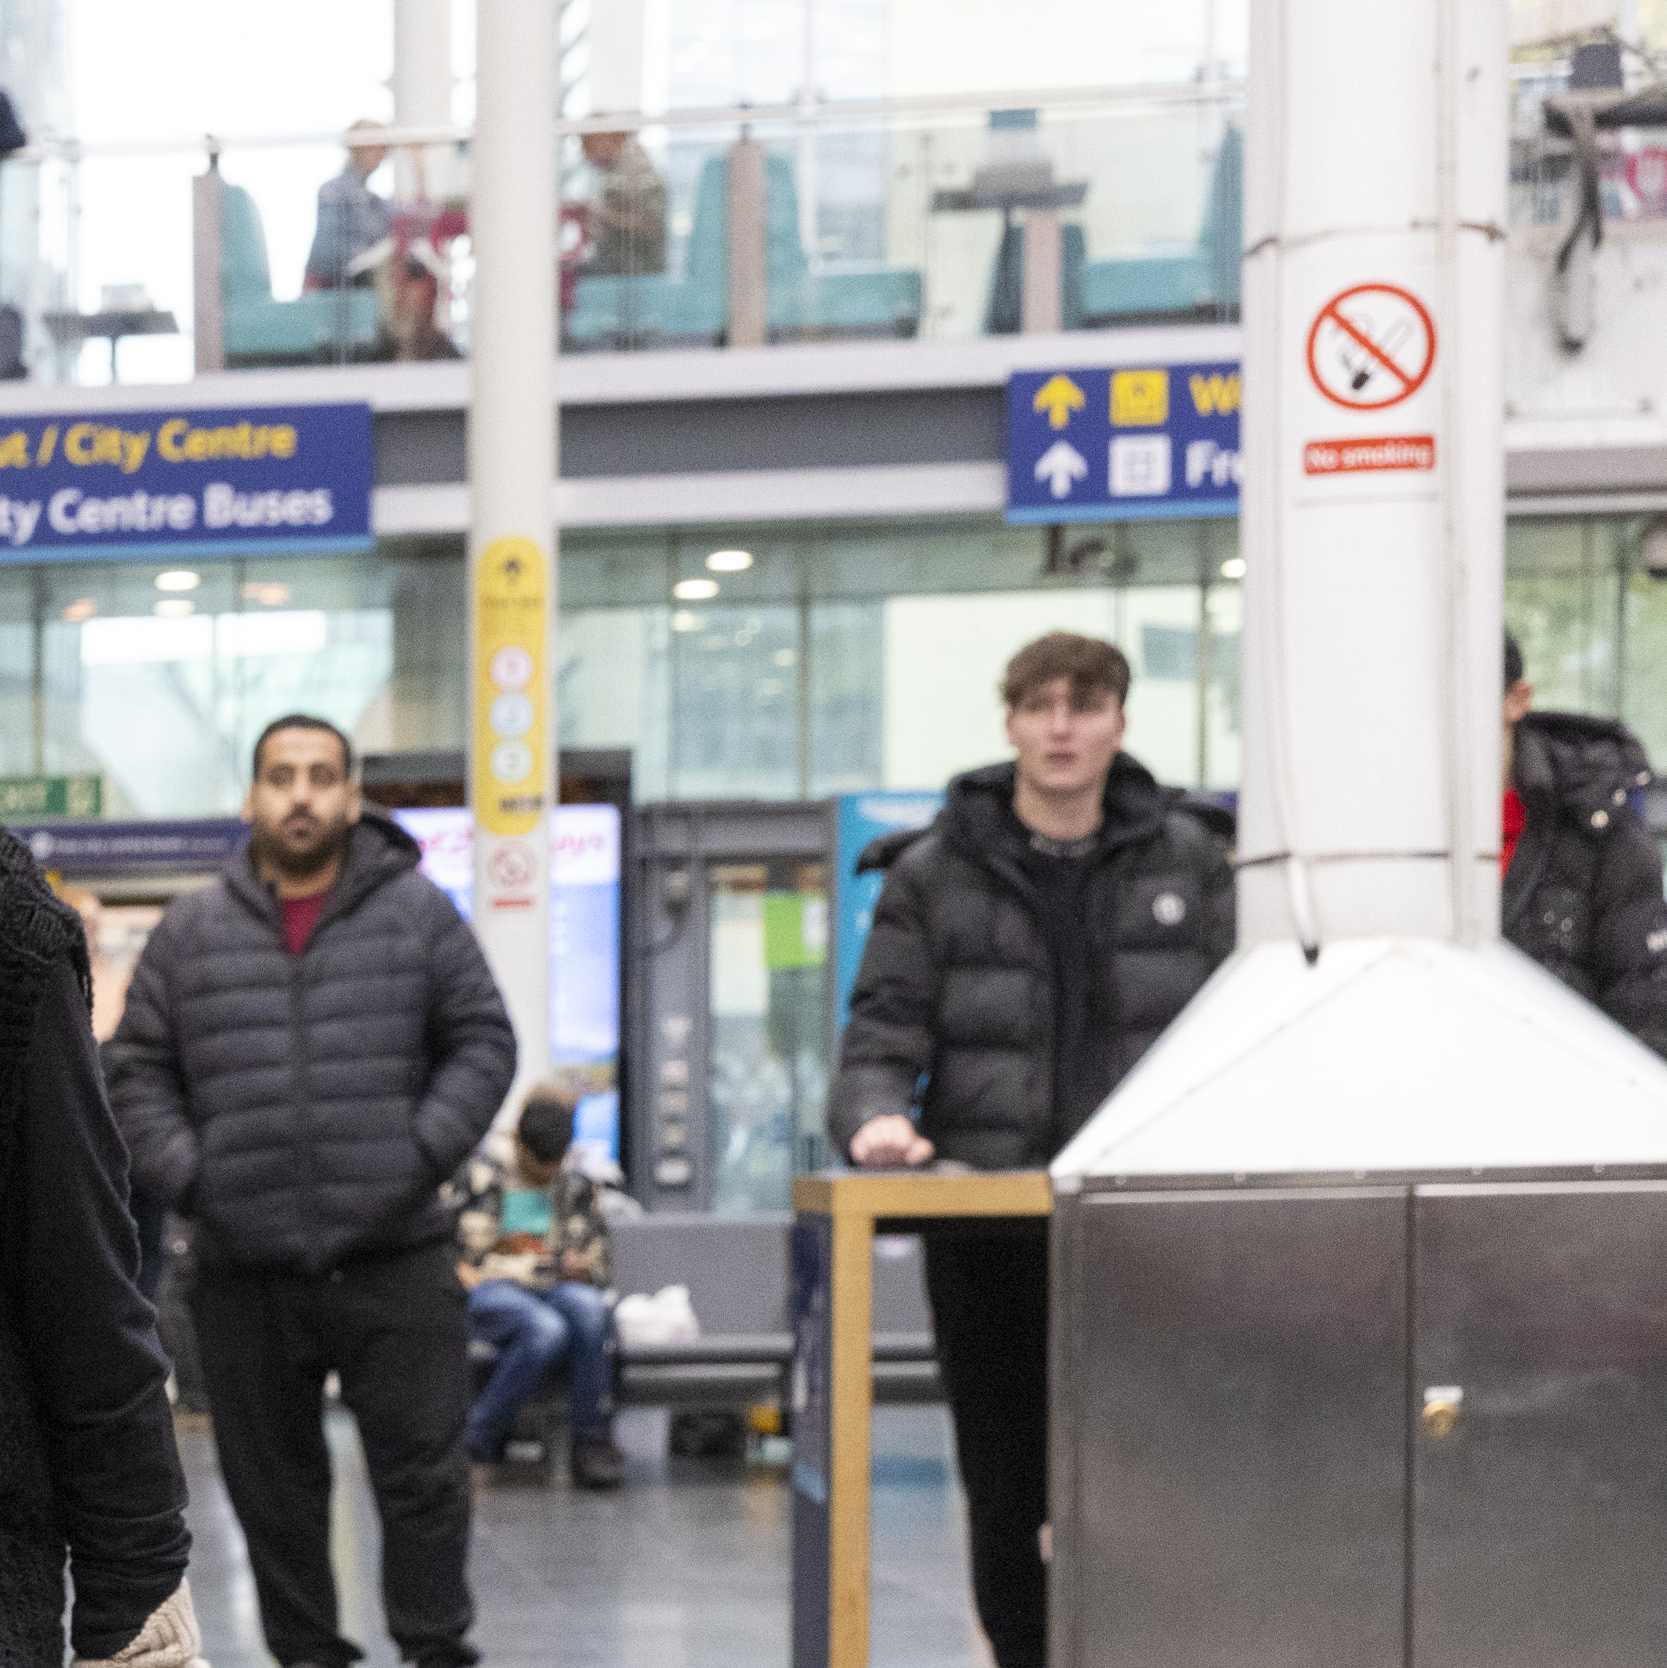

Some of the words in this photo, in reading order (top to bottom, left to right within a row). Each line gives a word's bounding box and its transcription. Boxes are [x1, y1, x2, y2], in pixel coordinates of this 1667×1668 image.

[1188, 372, 1243, 417] W
[64, 421, 151, 474] City
[157, 418, 297, 463] Centre
[48, 487, 197, 534] Centre
[202, 480, 335, 528] Buses
